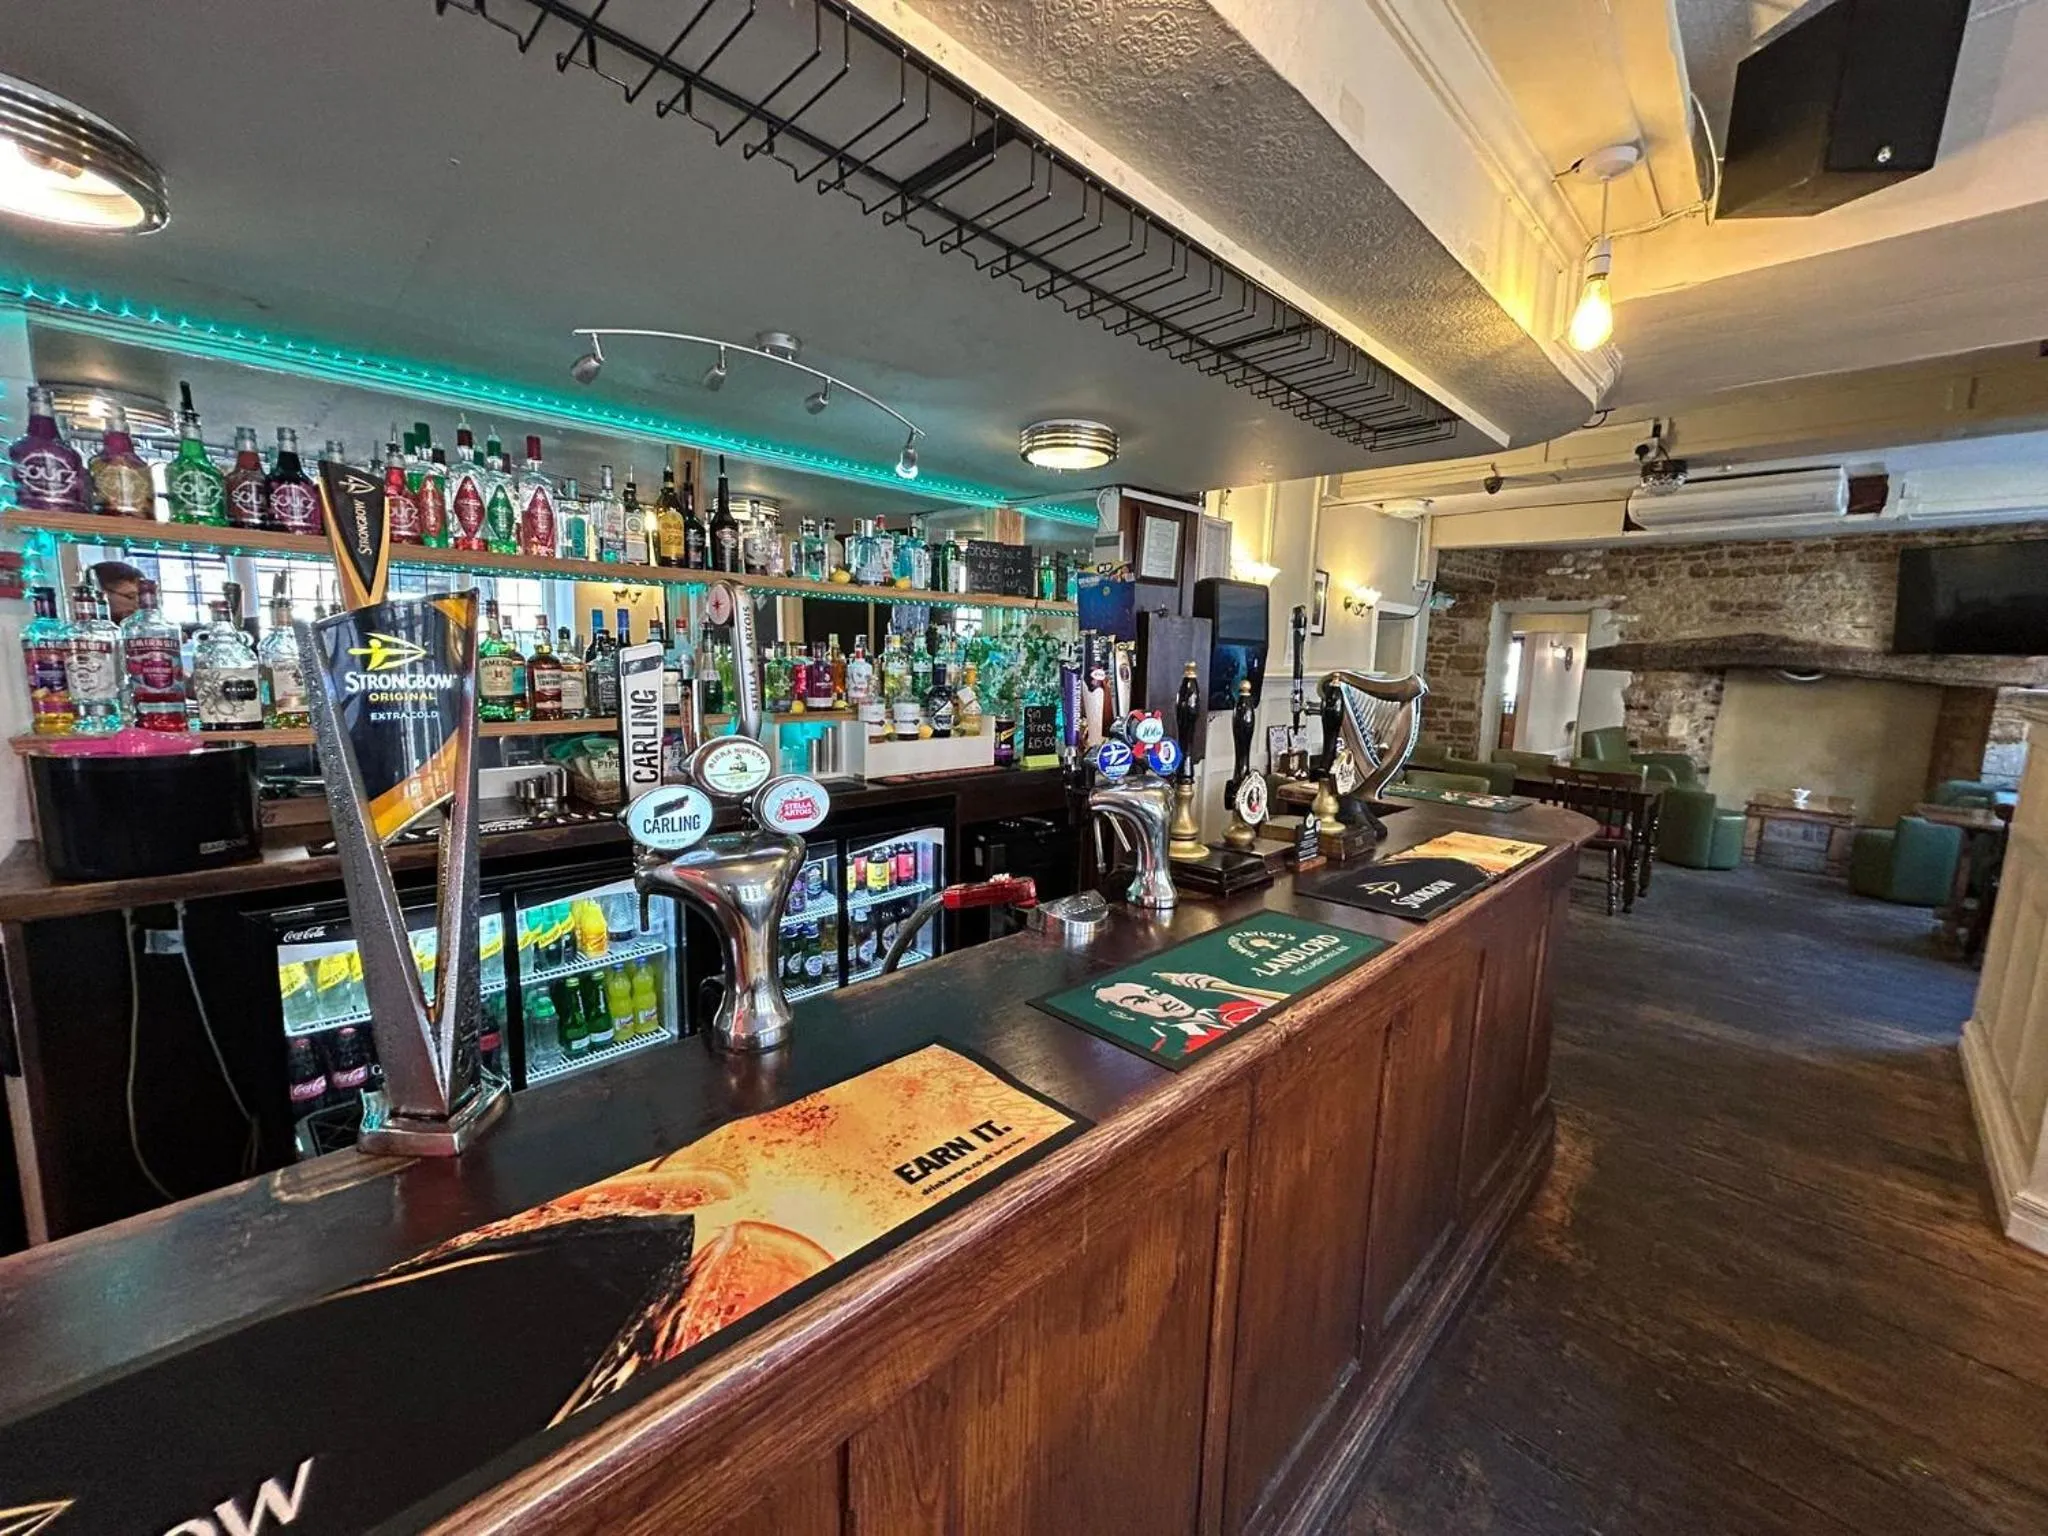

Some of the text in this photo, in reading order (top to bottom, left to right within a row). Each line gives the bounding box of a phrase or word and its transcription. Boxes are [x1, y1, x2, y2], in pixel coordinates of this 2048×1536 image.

[353, 498, 373, 556] STRONGBOW
[742, 605, 757, 650] ARTOIS
[344, 671, 453, 693] STRONGBOW
[368, 692, 437, 702] ORIGINAL
[370, 710, 439, 720] EXTRA COLD
[630, 689, 659, 784] CARLING
[784, 801, 812, 810] STELLA
[784, 808, 813, 817] ARTOIS
[643, 814, 701, 834] CARLING
[1250, 934, 1340, 977] LANDLORD
[892, 1135, 979, 1185] EARN
[969, 1118, 1014, 1144] IT.
